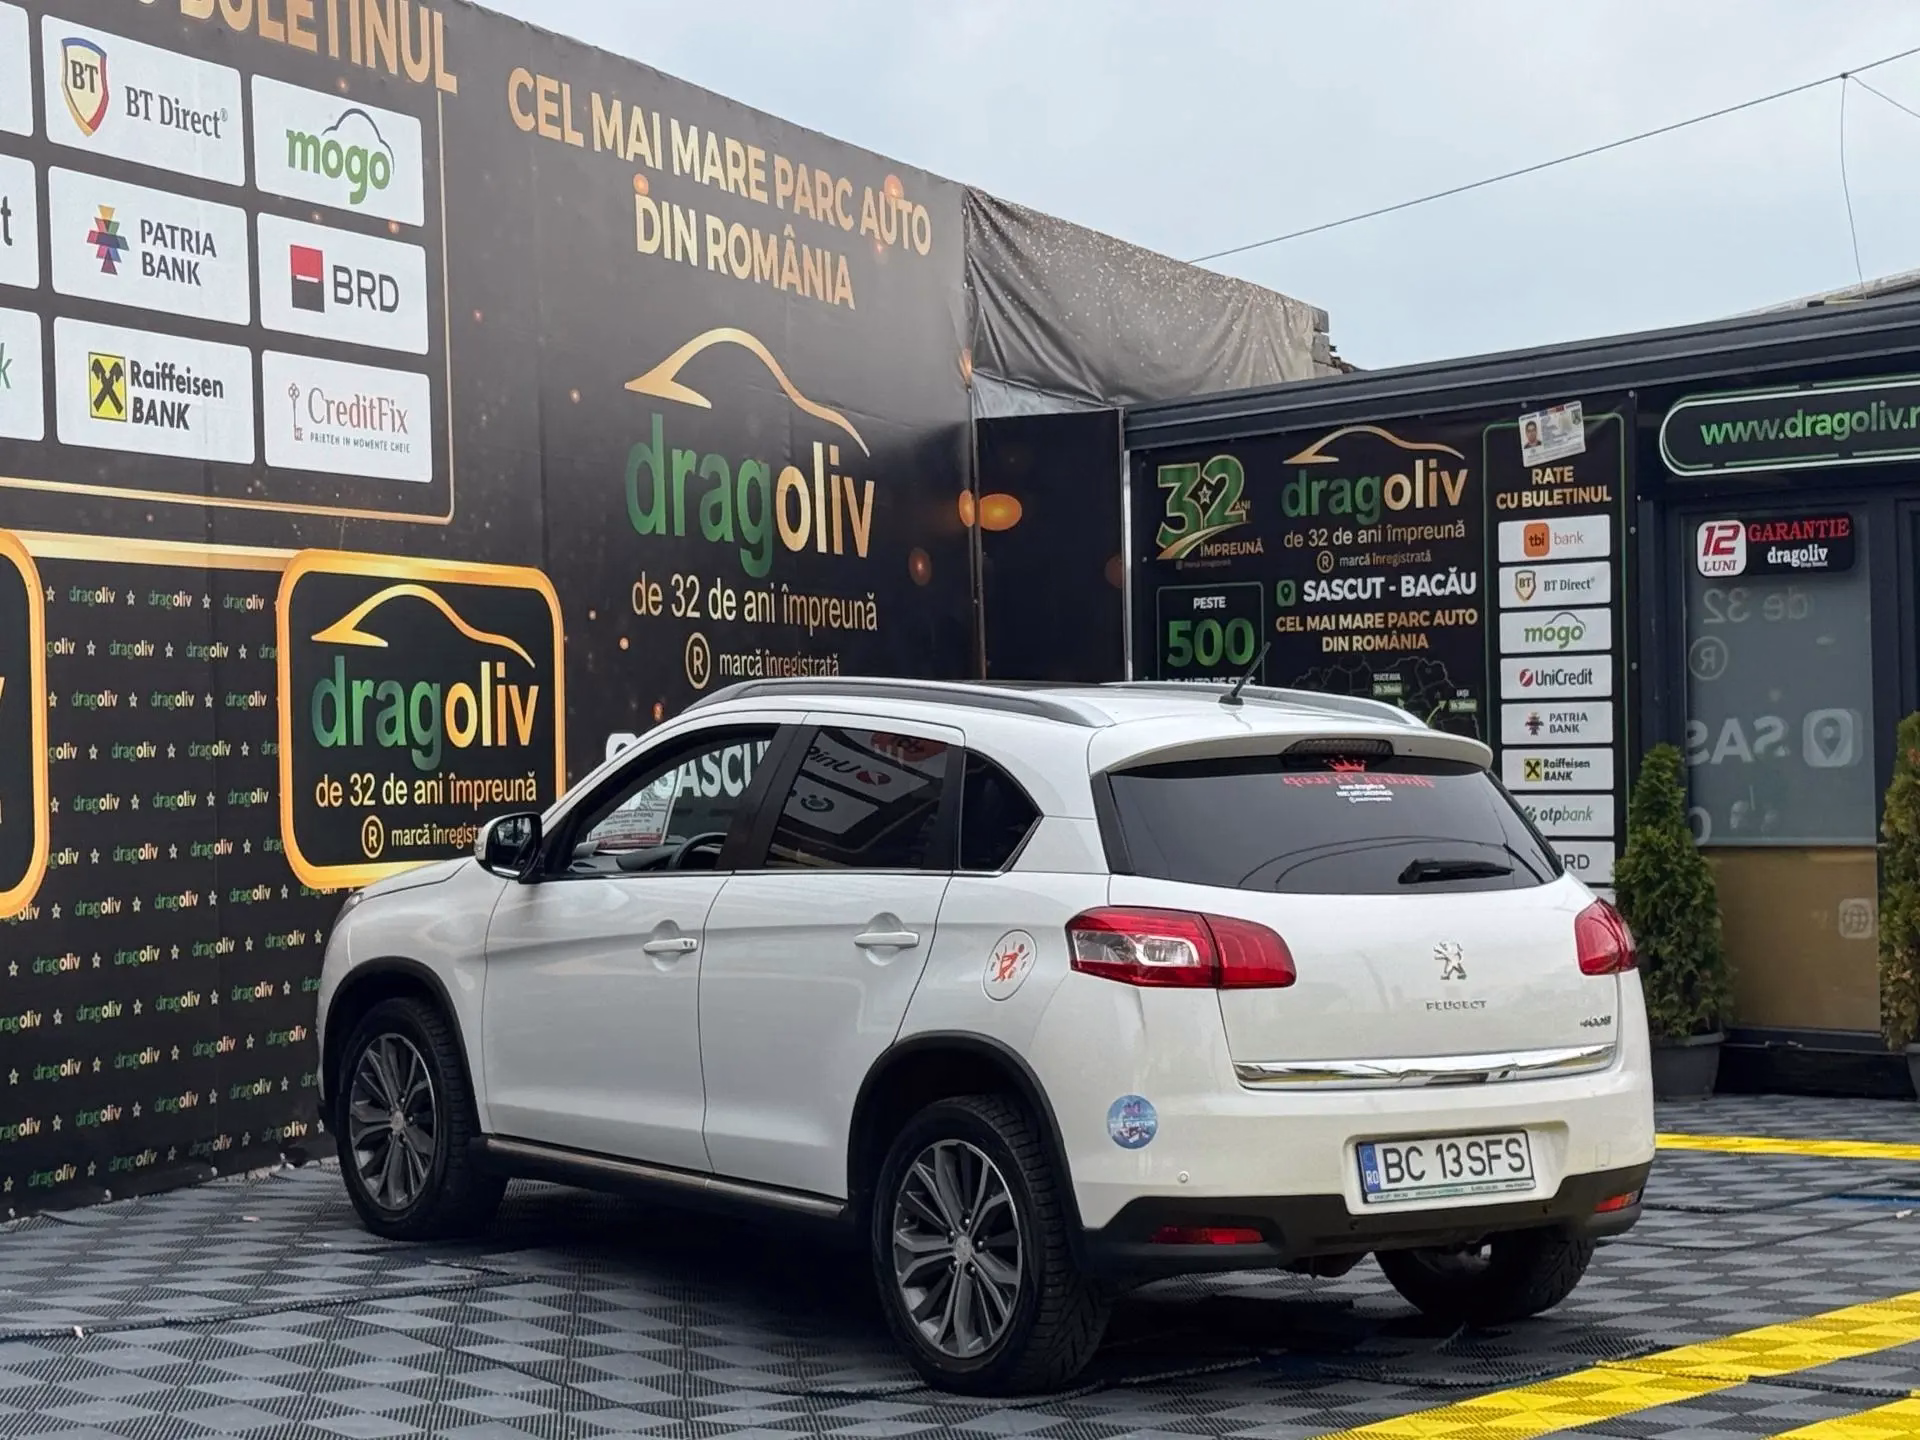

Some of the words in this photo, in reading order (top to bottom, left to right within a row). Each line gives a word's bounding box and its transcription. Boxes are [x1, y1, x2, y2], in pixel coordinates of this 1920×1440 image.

[70, 60, 98, 94] BT
[125, 85, 153, 121] BT
[286, 128, 390, 205] mogo
[508, 67, 584, 148] CEL
[591, 92, 663, 170] MAI
[670, 118, 768, 205] MARE
[774, 154, 854, 231] PARC
[860, 186, 932, 256] AUTO
[140, 219, 217, 258] PATRIA
[635, 193, 697, 267] DIN
[706, 214, 855, 310] ROMÂNIA
[142, 256, 201, 287] BANK
[333, 264, 399, 313] BRD
[130, 360, 224, 399] Raiffeisen
[132, 397, 190, 430] BANK
[308, 387, 408, 434] CreditFix
[343, 436, 350, 446] IN
[354, 438, 388, 451] MOMENTE
[1532, 466, 1574, 485] RATE
[625, 413, 875, 578] dragoliv
[1156, 455, 1246, 550] 32
[1281, 459, 1468, 525] dragoliv
[1496, 493, 1518, 509] CU
[1522, 485, 1612, 507] BULETINUL
[1284, 530, 1303, 548] de
[1308, 528, 1328, 547] 32
[1333, 527, 1352, 545] de
[1358, 525, 1382, 543] ani
[1387, 520, 1465, 546] împreună
[1528, 533, 1545, 547] tbi
[1554, 532, 1584, 546] bank
[1703, 524, 1740, 556] 12
[1748, 518, 1850, 542] GARANTIE
[1339, 553, 1370, 567] marcă
[1372, 550, 1432, 568] înregistrată
[1703, 560, 1737, 572] LUNI
[1767, 544, 1828, 567] dragoliv
[1303, 577, 1385, 602] SASCUT
[1401, 567, 1476, 597] BACĂU
[1519, 576, 1532, 588] BT
[1544, 580, 1558, 592] BT
[69, 587, 115, 607] dragoliv
[148, 590, 192, 609] dragoliv
[223, 594, 264, 613] dragoliv
[632, 571, 663, 617] de
[671, 573, 700, 618] 32
[709, 578, 737, 621] de
[744, 583, 775, 624] ani
[783, 584, 878, 636] împreună
[1193, 596, 1226, 610] PESTE
[1276, 616, 1303, 633] CEL
[1307, 614, 1335, 631] MAI
[1339, 613, 1384, 630] MARE
[1388, 610, 1430, 629] PARC
[1433, 608, 1478, 626] AUTO
[47, 637, 75, 657] goliv
[109, 639, 154, 659] dragoliv
[186, 642, 228, 660] dragoliv
[1167, 618, 1255, 667] 500
[1322, 636, 1349, 652] DIN
[1353, 630, 1429, 652] ROMÂNIA
[1524, 624, 1584, 649] mogo
[720, 648, 763, 676] marcă
[765, 648, 839, 677] înregistrată
[1535, 668, 1593, 686] UniCredit
[72, 691, 117, 711] dragoliv
[151, 692, 194, 711] dragoliv
[226, 692, 266, 709] dragoliv
[311, 655, 539, 770] dragoliv
[1549, 712, 1588, 722] PATRIA
[1549, 723, 1579, 733] BANK
[49, 743, 77, 763] goliv
[112, 743, 156, 762] dragoliv
[189, 741, 230, 760] dragoliv
[1544, 759, 1590, 769] Raiffeisen
[1544, 771, 1572, 781] BANK
[73, 796, 119, 815] dragoliv
[153, 791, 196, 810] dragoliv
[228, 788, 268, 806] dragoliv
[316, 774, 342, 808] de
[350, 773, 376, 806] 32
[383, 773, 408, 805] de
[414, 772, 443, 804] ani
[450, 771, 537, 811] împreună
[1540, 805, 1593, 826] otpbank
[392, 825, 430, 846] marcă
[49, 848, 78, 868] goliv
[113, 844, 158, 864] dragoliv
[191, 839, 232, 858] dragoliv
[75, 897, 121, 919] dragoliv
[154, 890, 198, 911] dragoliv
[229, 884, 271, 904] dragoliv
[32, 953, 80, 975] dragoliv
[114, 946, 160, 966] dragoliv
[192, 938, 234, 958] dragoliv
[265, 930, 305, 950] dragoliv
[0, 1010, 41, 1033] ragoliv
[76, 1001, 122, 1023] dragoliv
[155, 991, 200, 1013] dragoliv
[231, 983, 273, 1003] dragoliv
[33, 1059, 81, 1082] dragoliv
[114, 1047, 160, 1070] dragoliv
[192, 1037, 235, 1059] dragoliv
[266, 1026, 306, 1047] dragoliv
[0, 1117, 40, 1141] ragoliv
[76, 1104, 122, 1128] dragoliv
[154, 1092, 198, 1115] dragoliv
[229, 1079, 271, 1101] dragoliv
[28, 1165, 76, 1188] dragoliv
[108, 1150, 157, 1172] dragoliv
[188, 1134, 232, 1157] dragoliv
[263, 1121, 307, 1142] dragoliv
[1383, 1147, 1425, 1184] BC
